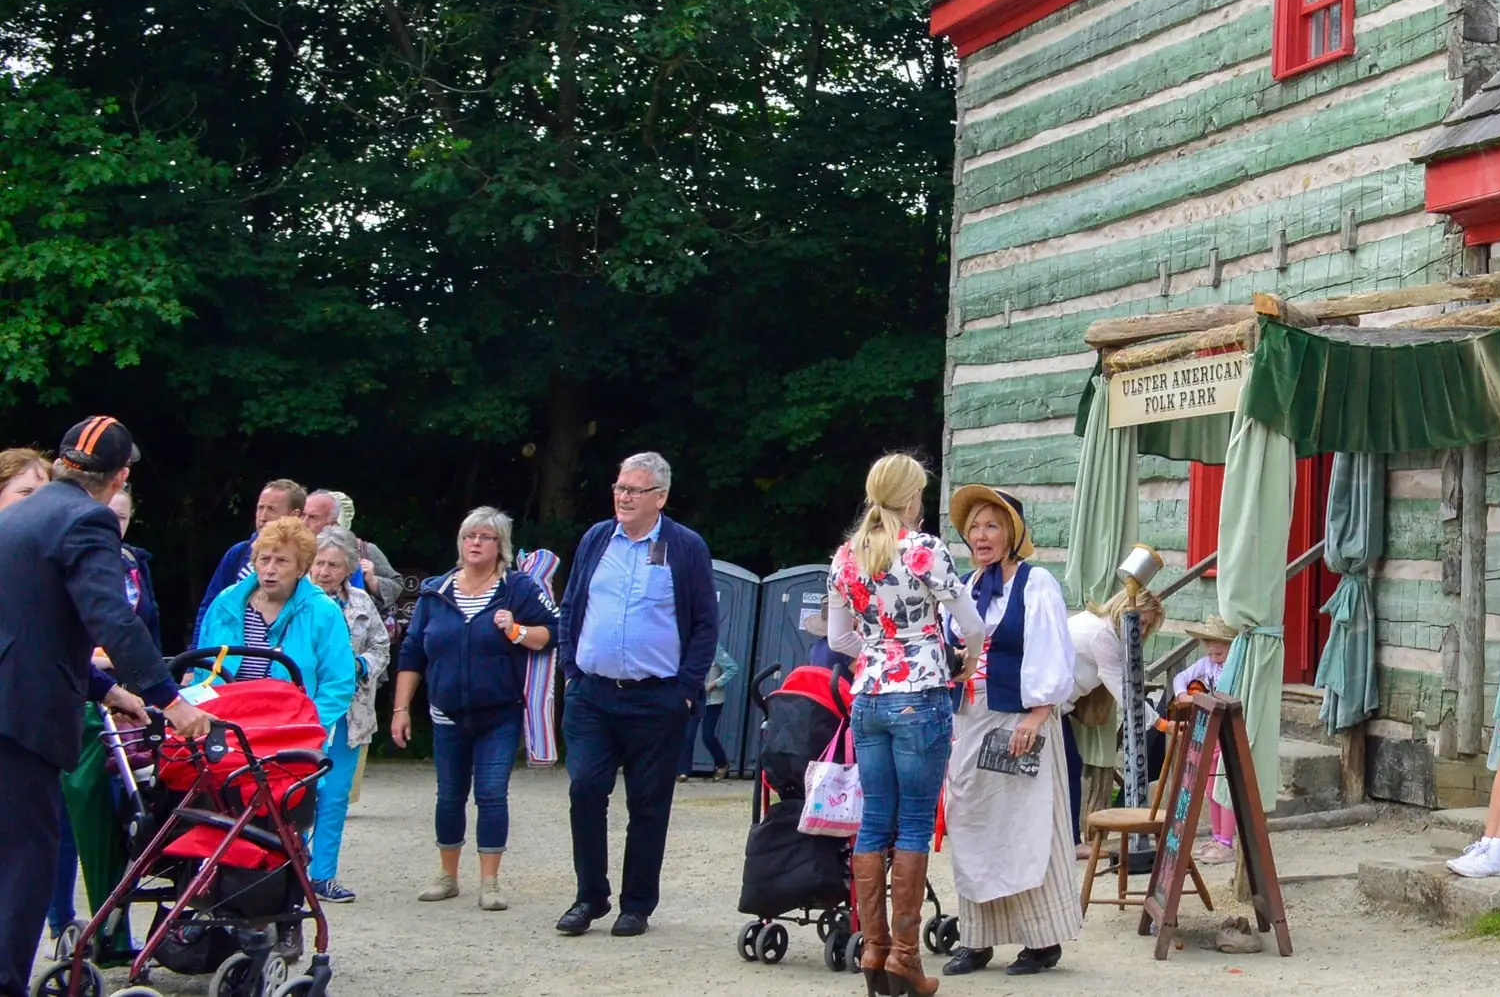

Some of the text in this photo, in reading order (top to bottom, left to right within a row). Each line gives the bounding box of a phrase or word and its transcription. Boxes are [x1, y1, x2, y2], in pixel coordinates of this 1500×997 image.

[1122, 360, 1243, 397] ULSTER AMERICAN
[1145, 387, 1216, 413] FOLK PARK
[1132, 681, 1144, 748] PARK
